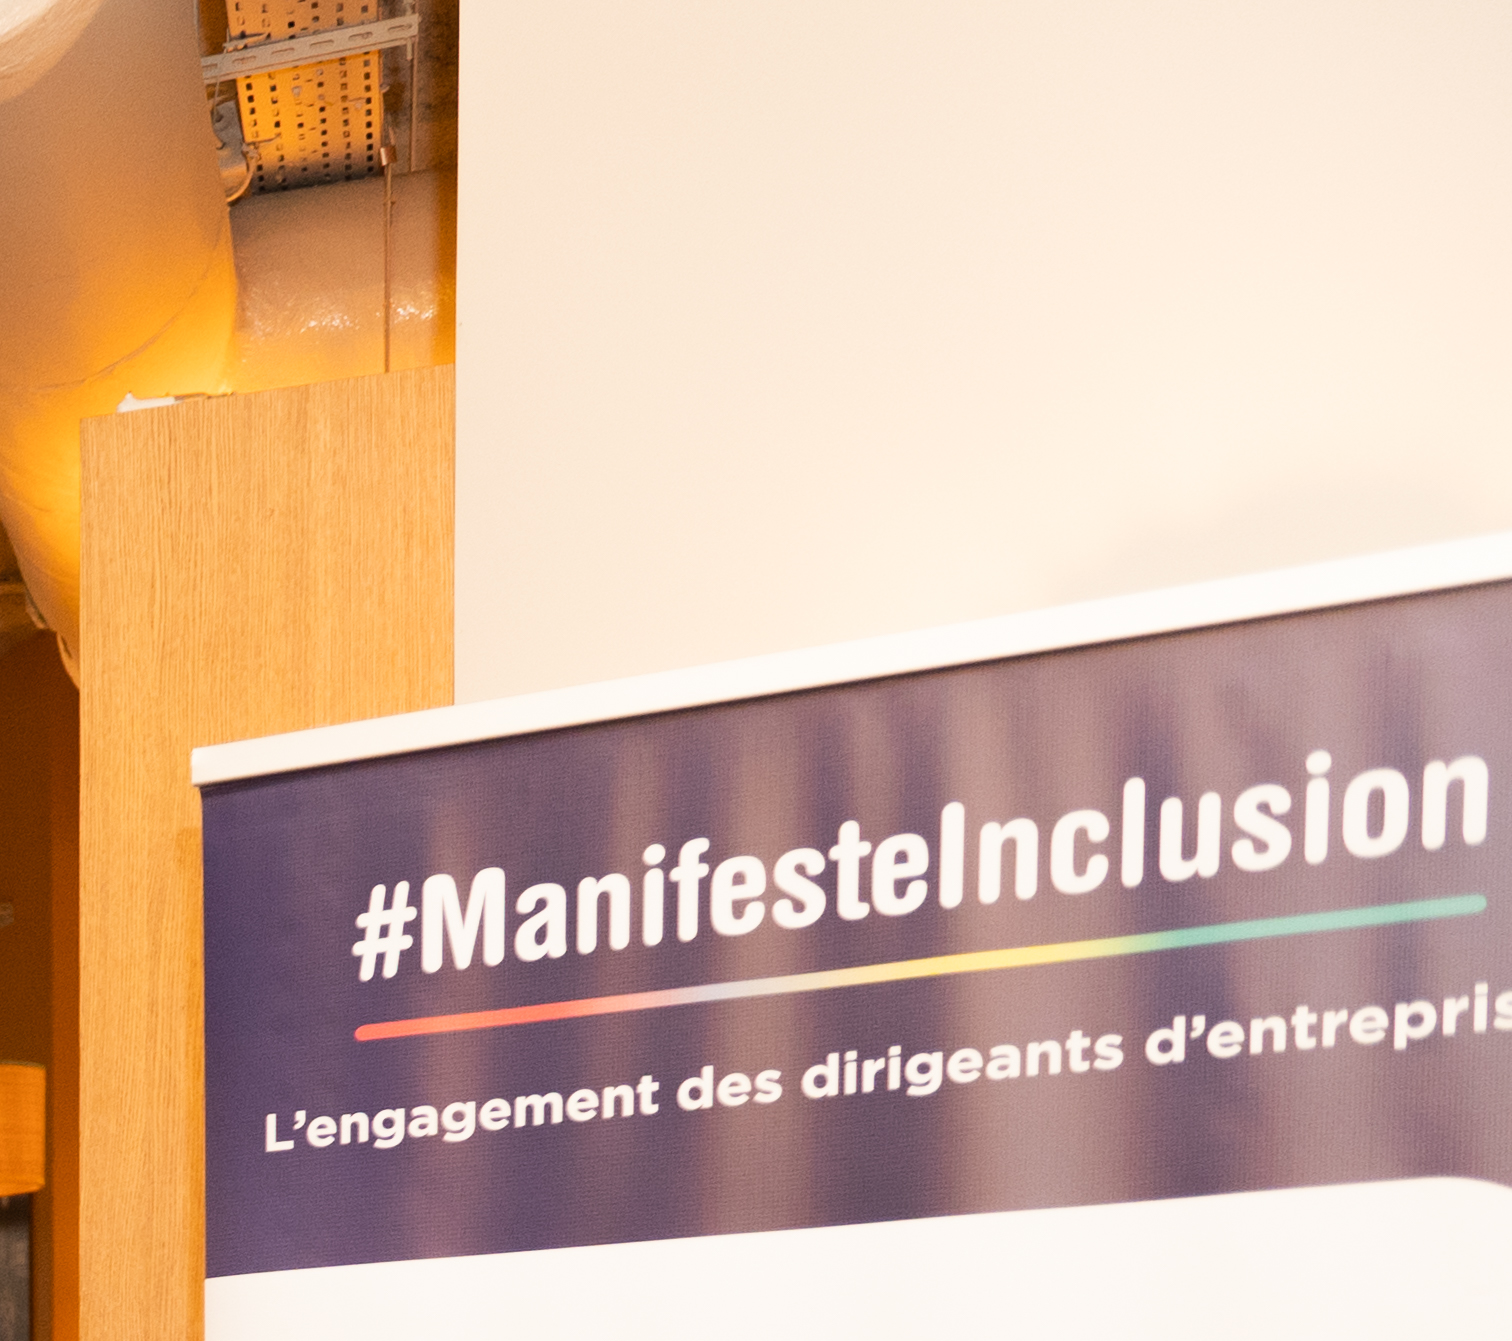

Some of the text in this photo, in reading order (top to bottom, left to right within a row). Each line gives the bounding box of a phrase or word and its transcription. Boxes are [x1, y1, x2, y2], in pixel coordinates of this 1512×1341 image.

[350, 748, 1490, 983] #ManifesteInclusion
[265, 1074, 660, 1153] L'engagement
[677, 1065, 783, 1111] des
[801, 1025, 1125, 1099] dirigeants
